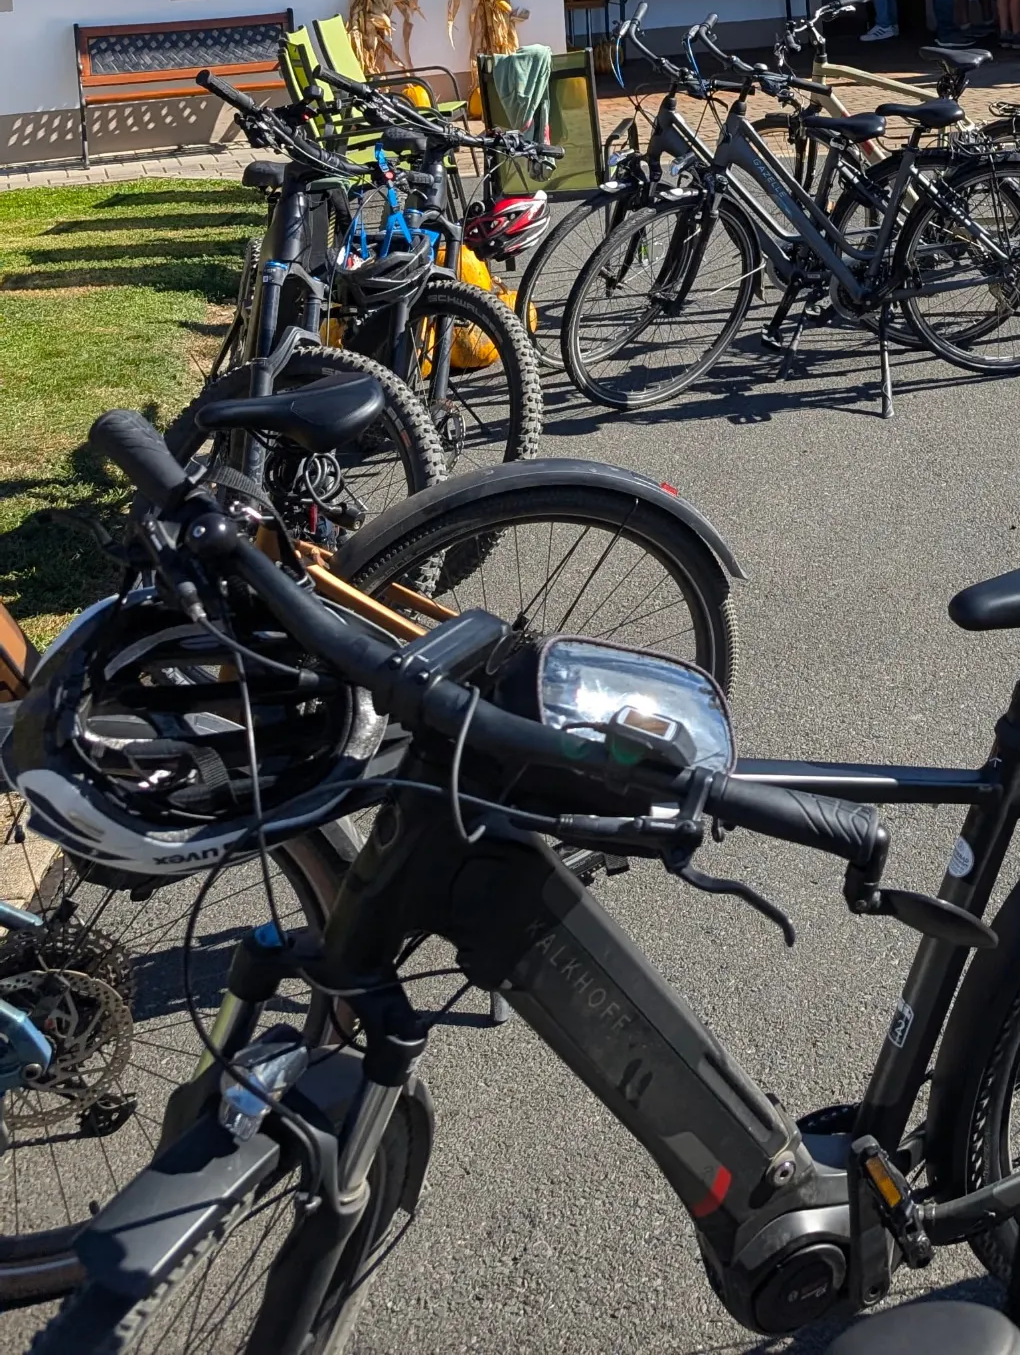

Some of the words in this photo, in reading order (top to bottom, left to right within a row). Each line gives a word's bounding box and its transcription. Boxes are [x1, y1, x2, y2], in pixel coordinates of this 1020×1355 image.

[752, 158, 788, 198] GAZELLE
[152, 847, 219, 866] uvex
[524, 917, 632, 1032] KALKHOFF
